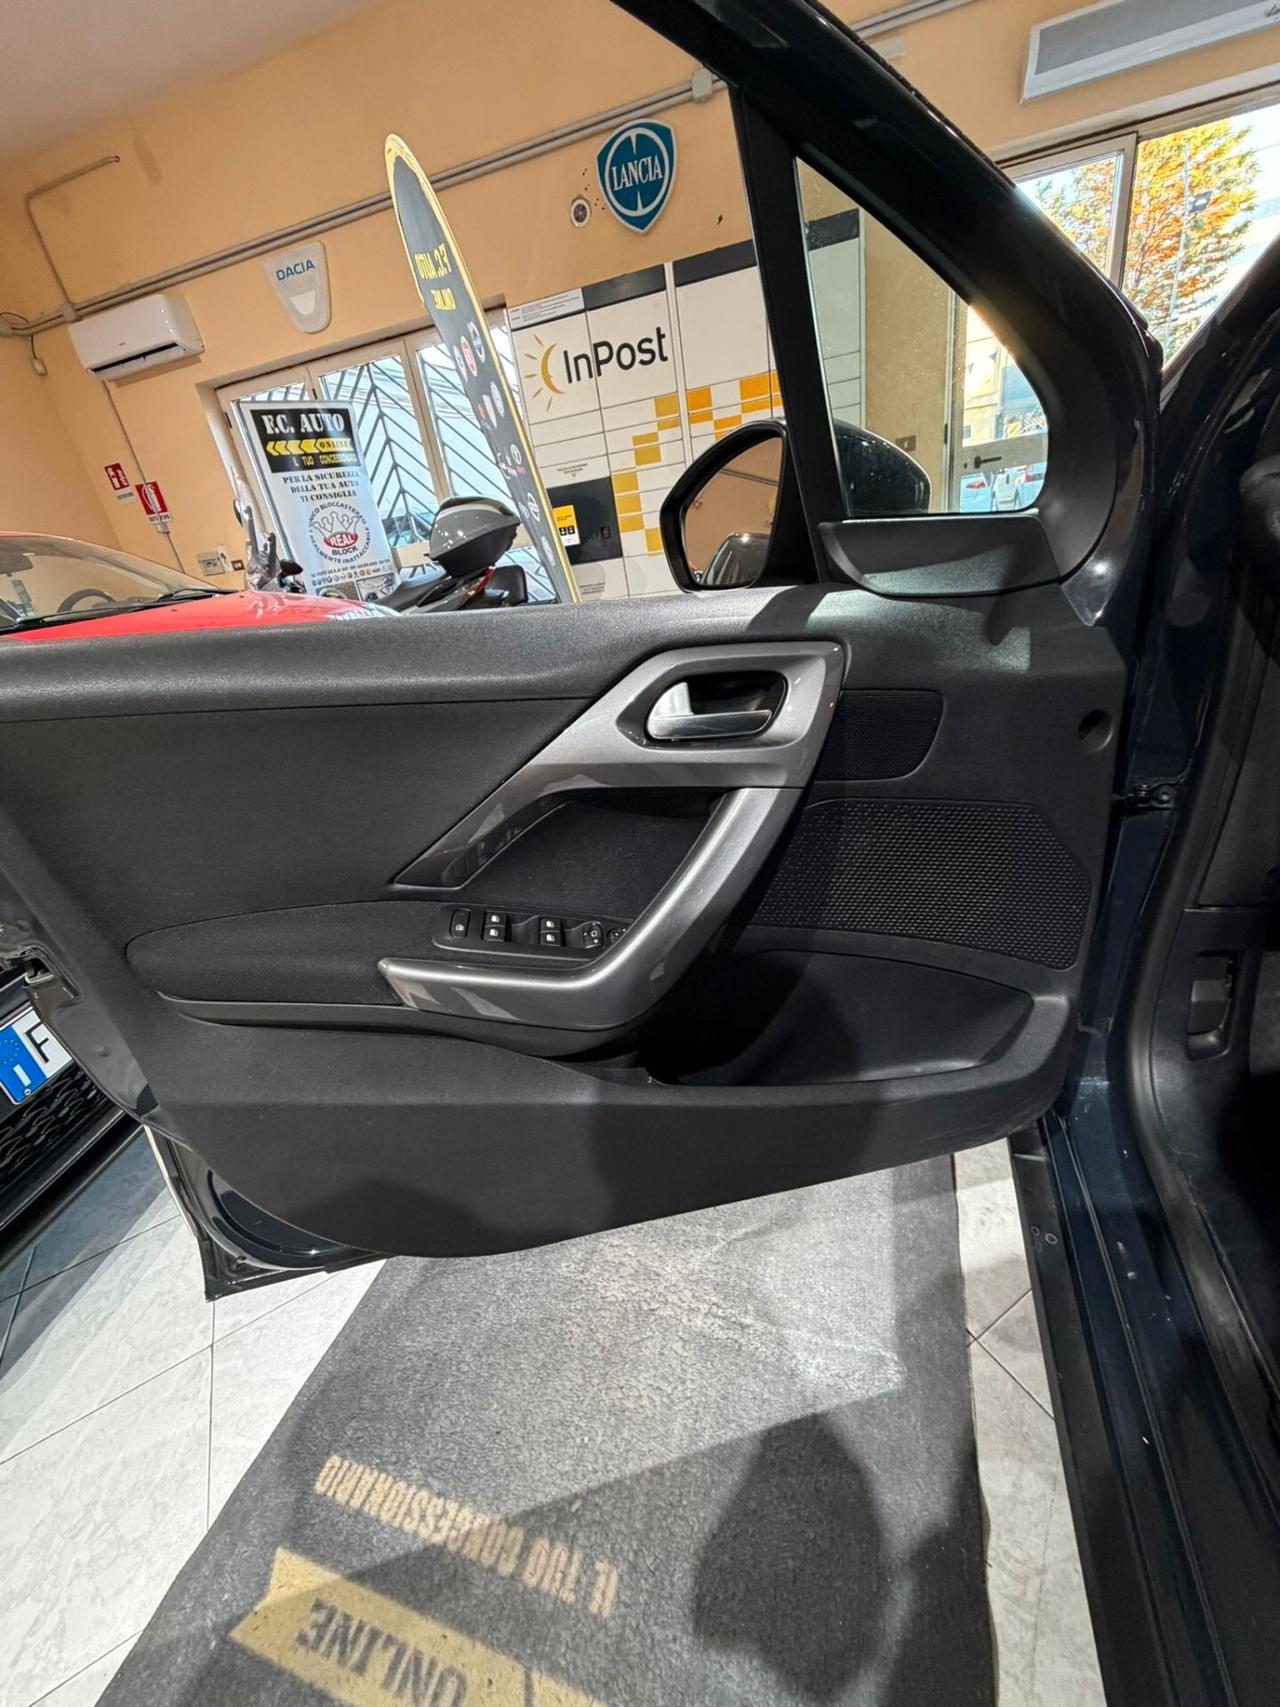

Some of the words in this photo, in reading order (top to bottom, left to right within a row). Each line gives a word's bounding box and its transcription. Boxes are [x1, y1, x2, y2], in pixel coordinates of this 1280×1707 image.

[612, 154, 663, 191] LANCIA
[276, 259, 315, 280] DACIA
[563, 326, 668, 384] InPost
[300, 413, 345, 433] AUTO
[290, 484, 317, 494] DELLA
[318, 482, 336, 491] TUA
[339, 480, 360, 489] AUTO
[301, 474, 313, 483] LA
[314, 470, 360, 481] SICUREZZA
[310, 489, 357, 501] CONSIGLIA
[330, 532, 355, 547] REAL
[332, 545, 359, 556] BLOCK
[313, 1454, 525, 1578] CONCESSIONARIO
[522, 1537, 582, 1604] TUO
[588, 1559, 618, 1618] IL
[296, 1598, 468, 1707] ONLINE
